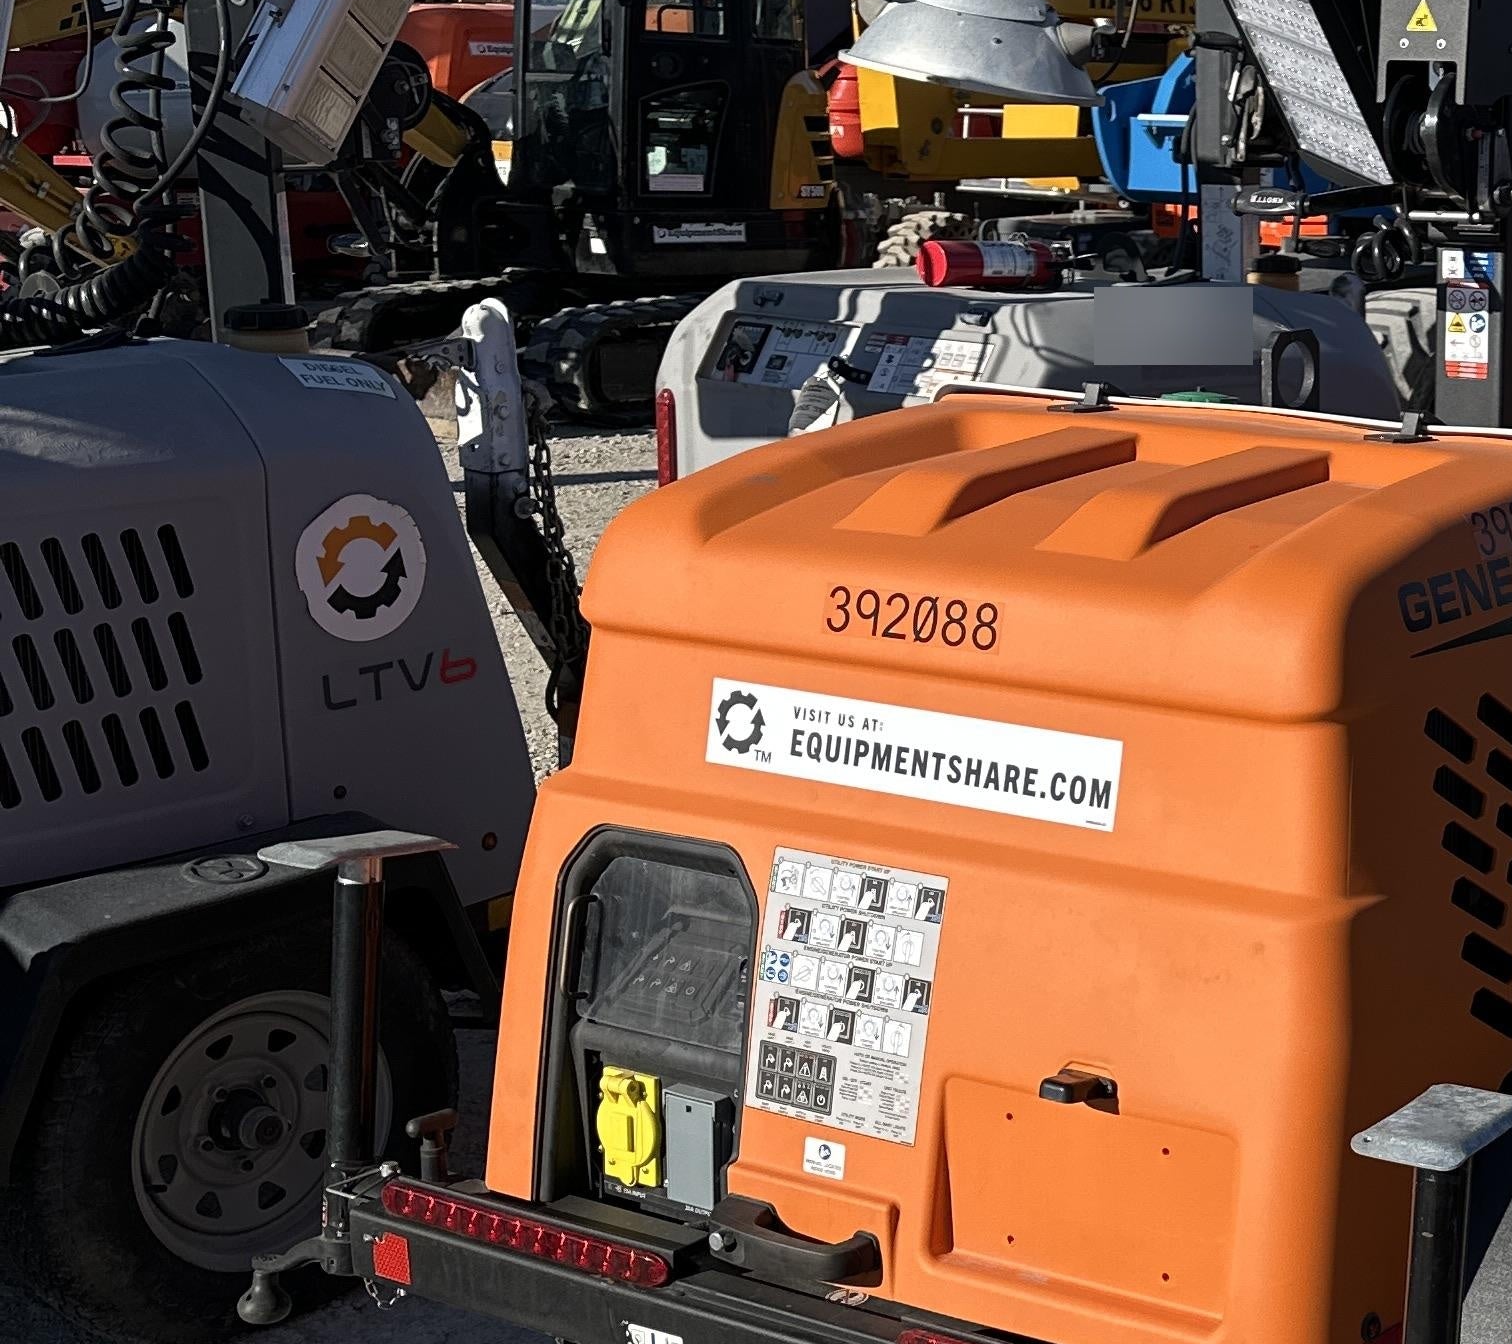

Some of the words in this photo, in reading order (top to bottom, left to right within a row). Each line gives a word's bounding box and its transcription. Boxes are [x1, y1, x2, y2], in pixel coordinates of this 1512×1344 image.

[299, 374, 344, 386] FUEL
[345, 377, 386, 392] ONLY
[302, 362, 362, 376] DIESEL
[825, 584, 1000, 652] 392088
[321, 648, 477, 711] LTV6
[792, 706, 831, 725] VISIT
[838, 712, 855, 728] US
[862, 717, 885, 733] AT:
[789, 729, 1112, 810] EQUIPMENTSHARE.COM
